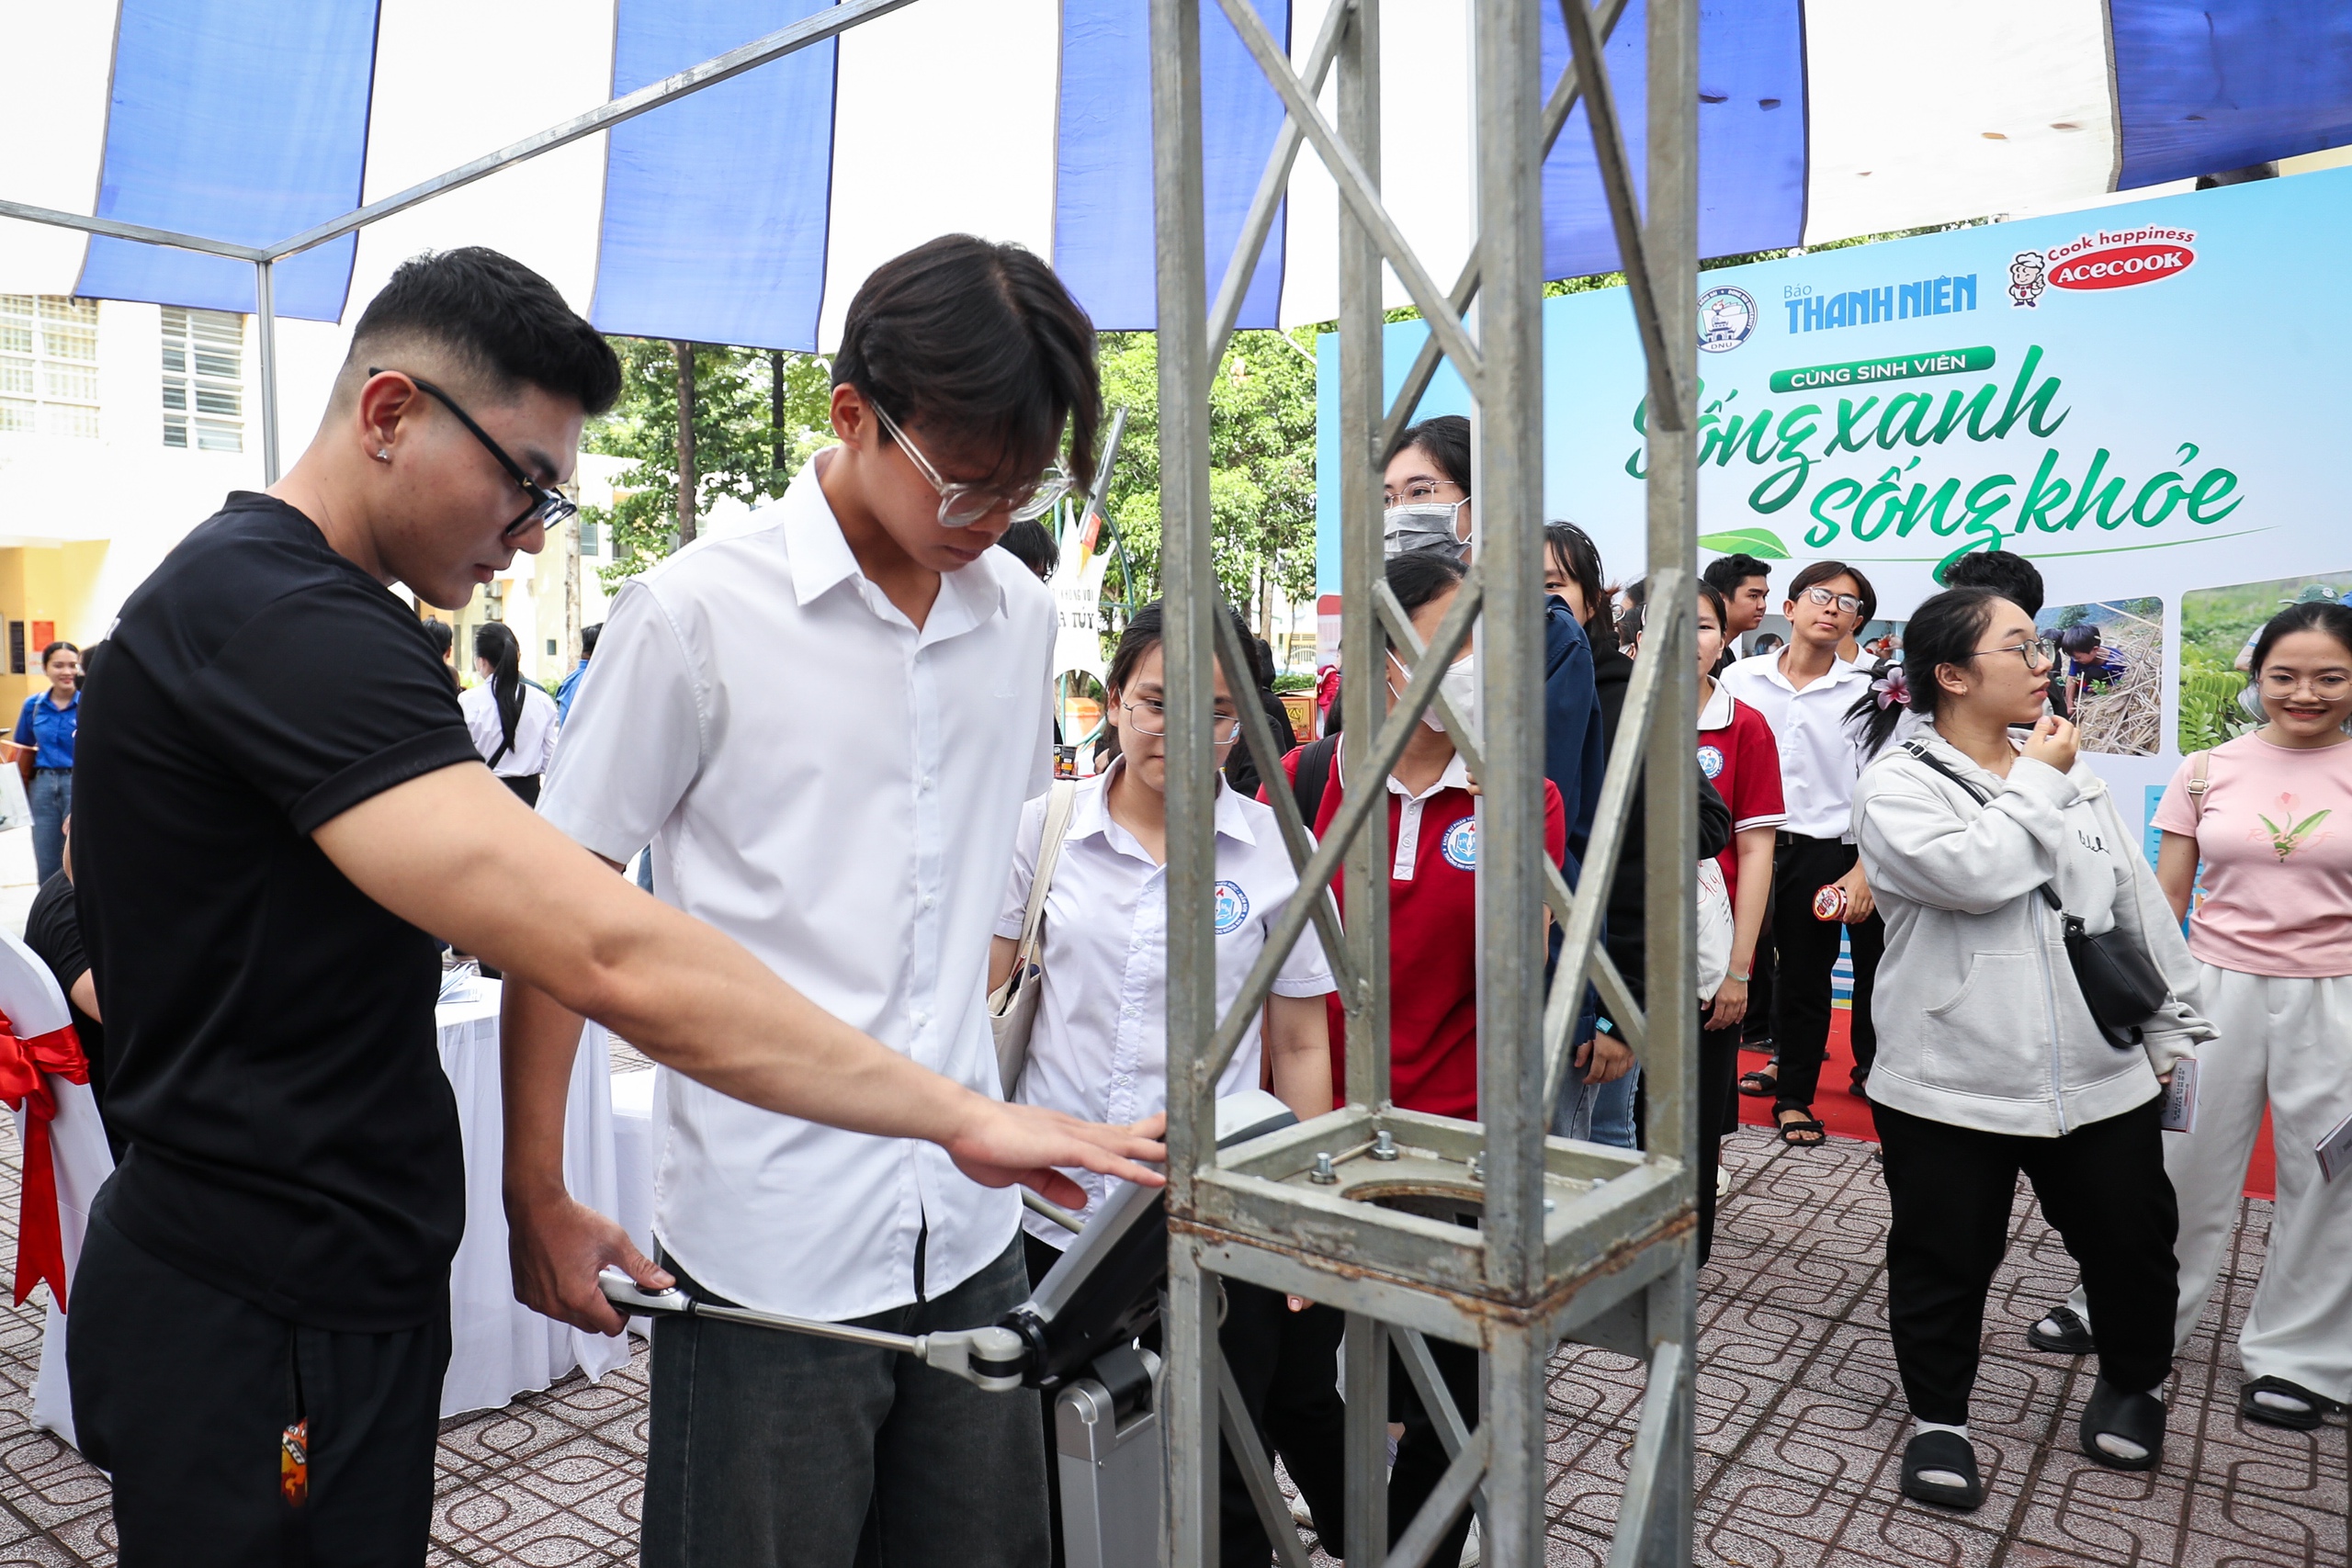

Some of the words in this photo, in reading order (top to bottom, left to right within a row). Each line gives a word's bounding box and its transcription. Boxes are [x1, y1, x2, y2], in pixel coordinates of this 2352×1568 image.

[2048, 236, 2093, 262] Cook
[2099, 226, 2195, 245] happiness
[1783, 283, 1812, 299] Báo
[1784, 285, 1894, 334] THANH
[1898, 274, 1977, 320] NIÊN
[1711, 342, 1733, 350] DNU
[1791, 368, 1850, 389] CÙNG
[1857, 361, 1907, 381] SINH
[1913, 354, 1966, 374] VIÊN
[1824, 344, 2072, 457] xanh
[1804, 457, 2016, 589] sống
[2014, 443, 2245, 534] khỏe
